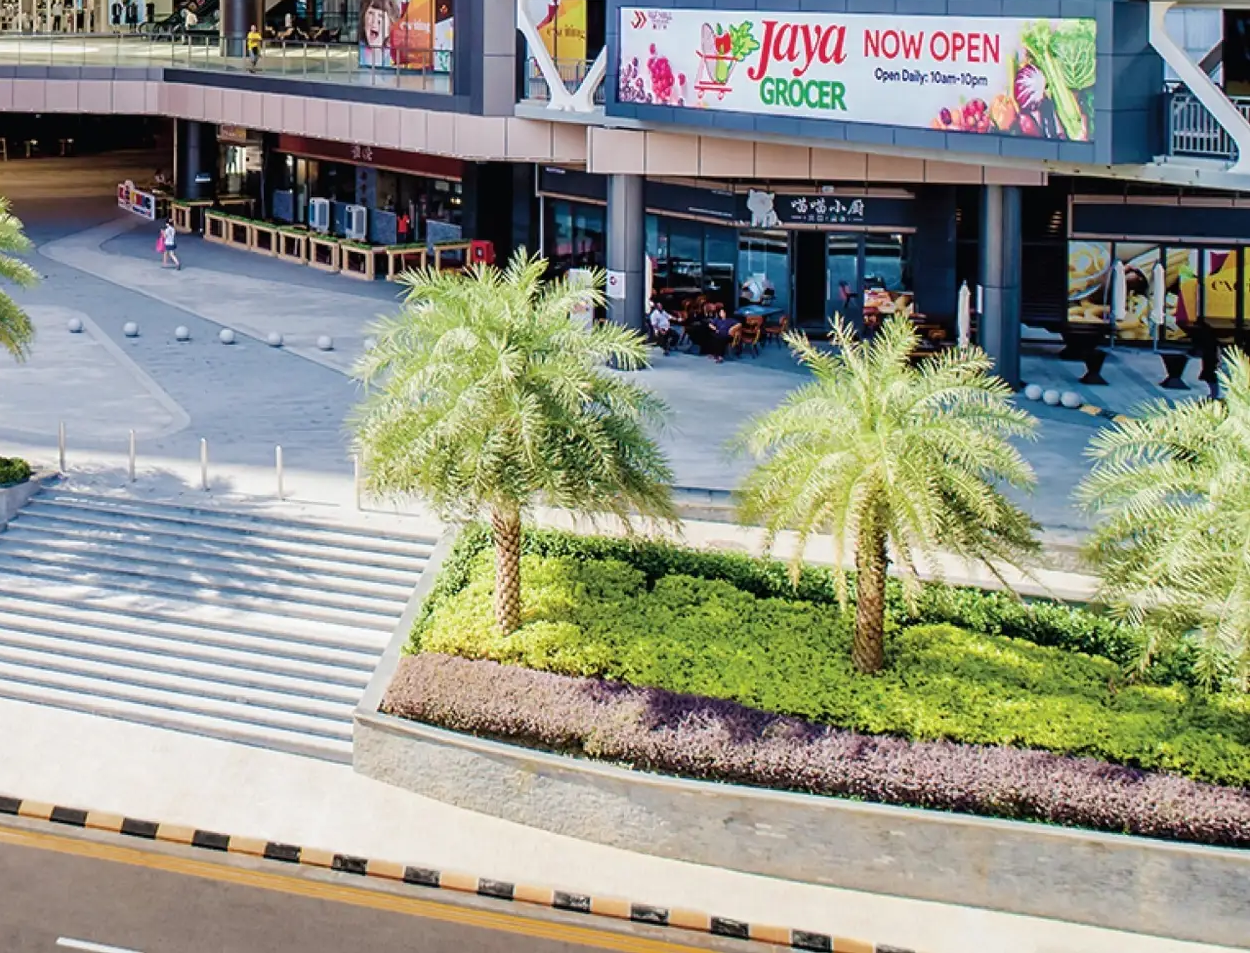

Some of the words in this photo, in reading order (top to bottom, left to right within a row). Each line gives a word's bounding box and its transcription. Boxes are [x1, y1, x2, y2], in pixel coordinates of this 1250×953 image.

[747, 20, 847, 80] Jaya
[864, 29, 924, 59] NOW
[930, 31, 1000, 63] OPEN
[760, 76, 847, 111] GROCER
[874, 67, 900, 83] Open
[902, 69, 928, 85] Daily:
[930, 71, 988, 88] 10am-10pm
